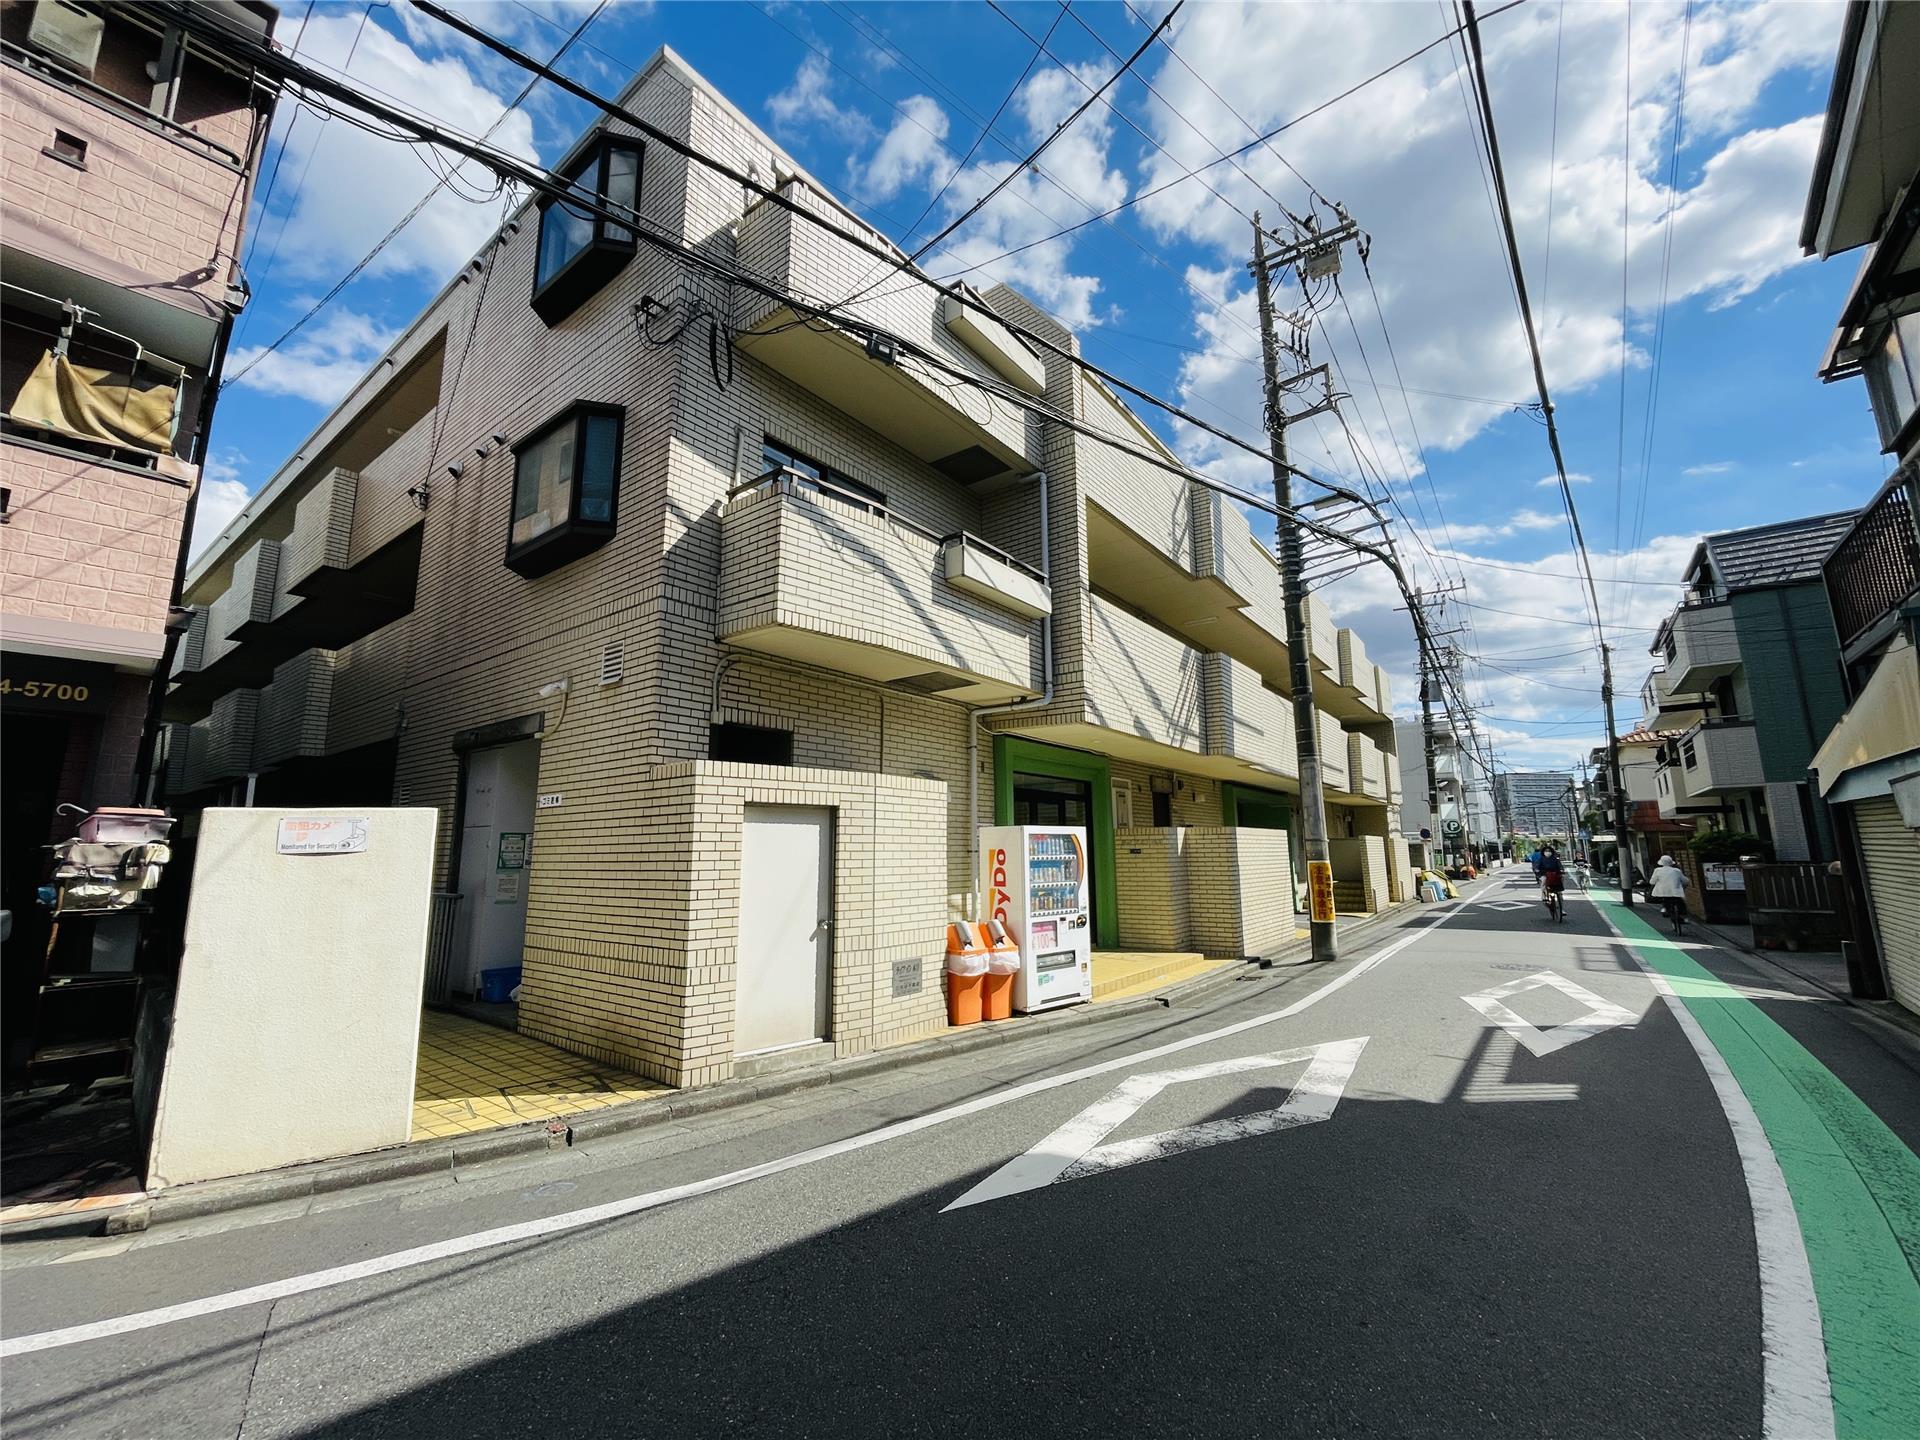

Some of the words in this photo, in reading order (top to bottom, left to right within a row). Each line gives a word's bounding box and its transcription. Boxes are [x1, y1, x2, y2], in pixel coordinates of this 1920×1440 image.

[0, 679, 89, 701] 4-5700
[1450, 821, 1459, 831] P
[316, 842, 338, 850] Security
[993, 848, 1011, 926] DyDo
